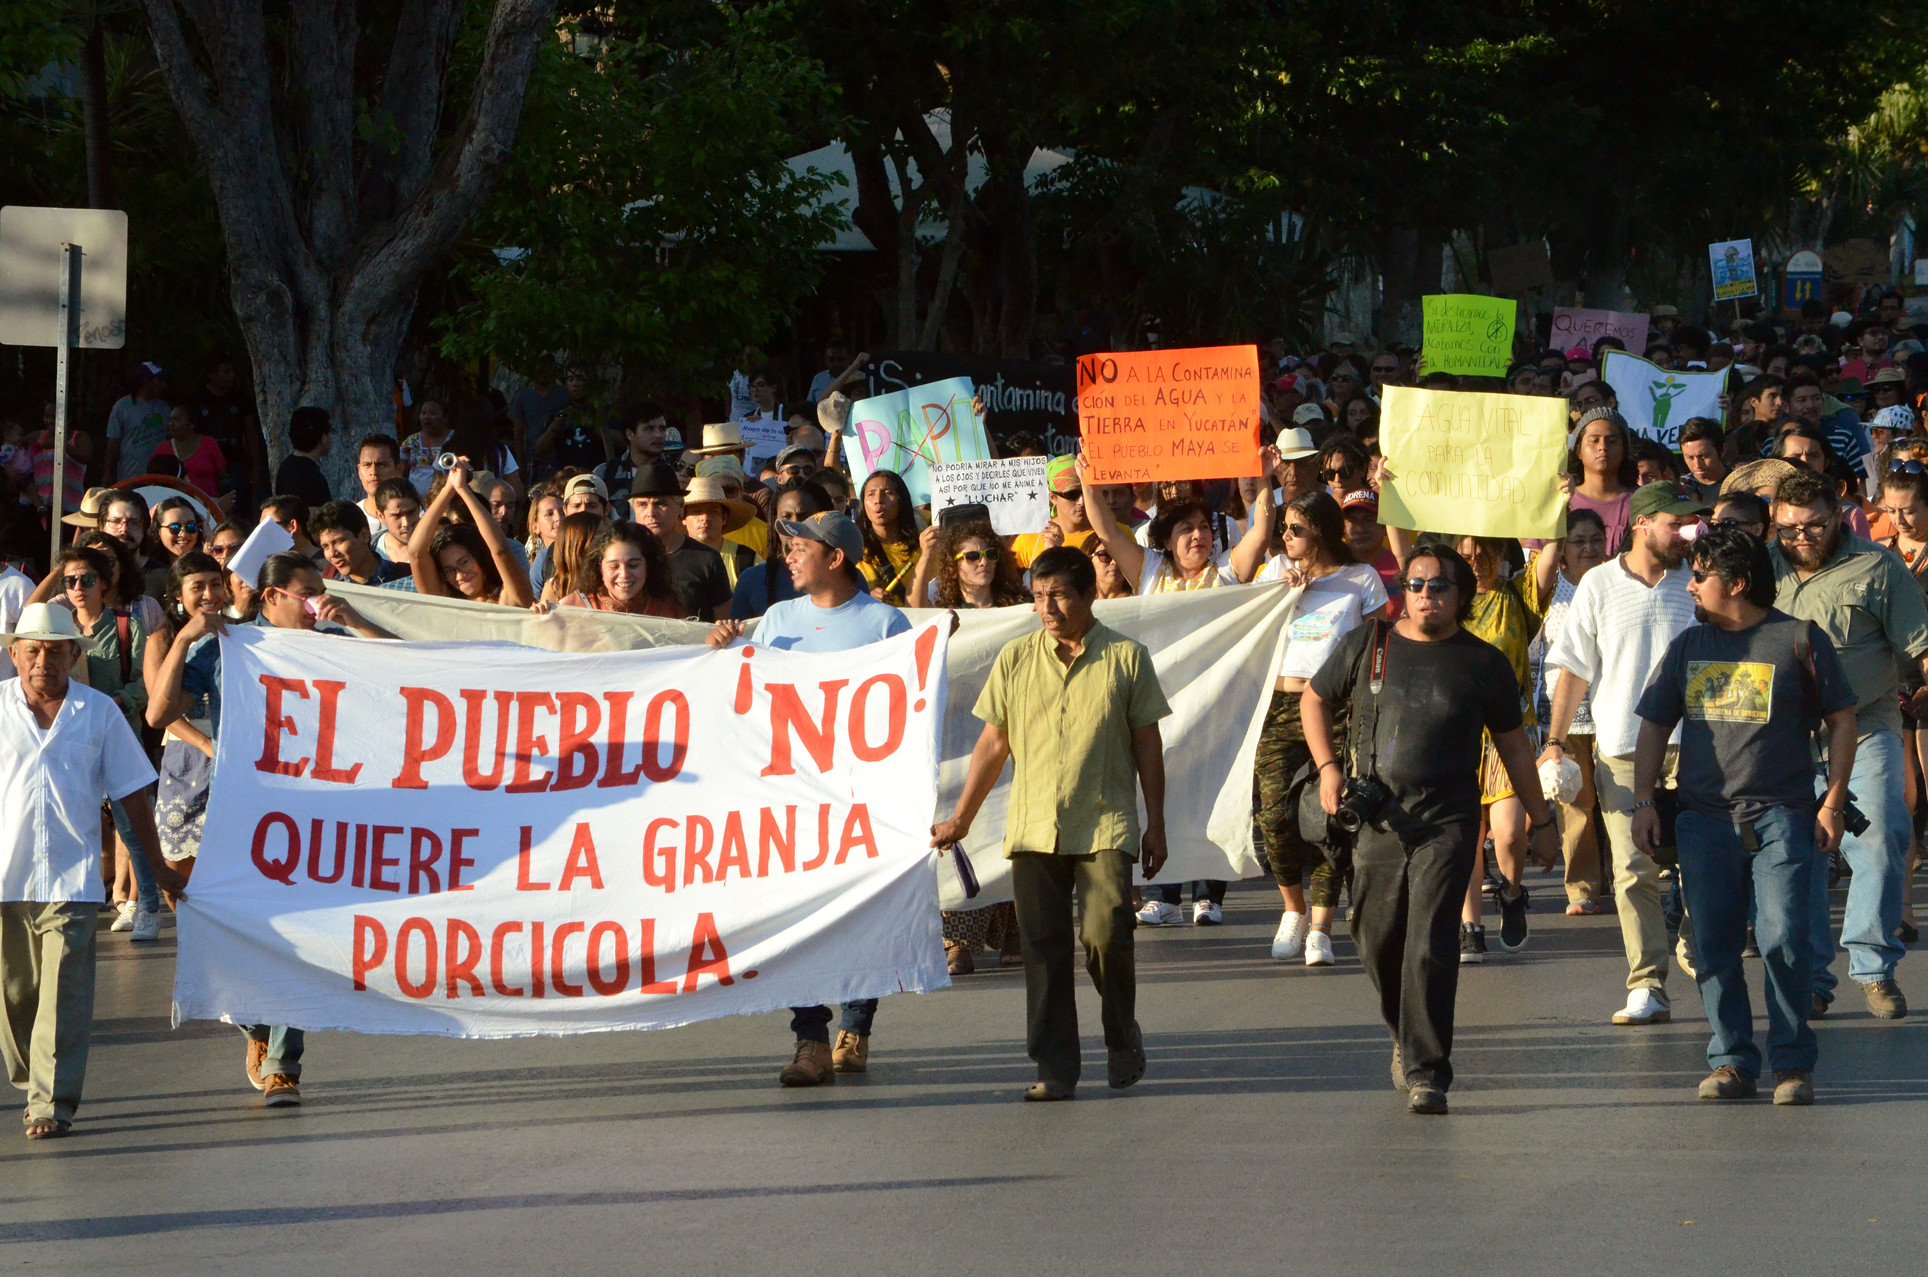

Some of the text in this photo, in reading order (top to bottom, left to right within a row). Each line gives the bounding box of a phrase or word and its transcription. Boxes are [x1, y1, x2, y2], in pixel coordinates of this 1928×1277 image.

[1555, 314, 1637, 340] QUEREMOS
[1126, 366, 1140, 383] A
[1146, 366, 1166, 383] LA
[978, 371, 1066, 416] ontamina
[1124, 394, 1147, 407] DEL
[1154, 386, 1207, 408] AGUA
[1215, 393, 1224, 405] Y
[1232, 392, 1247, 404] LA
[1083, 415, 1146, 435] TIERRA
[1159, 418, 1175, 431] EN
[1417, 403, 1530, 436] AGUA VITAL
[1113, 443, 1163, 459] PUEBLO
[1172, 438, 1215, 457] MAYA
[1224, 441, 1240, 454] SE
[1428, 445, 1493, 465] PARA LA
[932, 464, 943, 473] NO
[975, 461, 998, 469] MIRAR
[1000, 460, 1006, 468] A
[1008, 458, 1021, 467] MIS
[1023, 457, 1046, 466] HIJOS
[936, 467, 1045, 483] A LOS OJOS Y DECIRLES QUE VIVEN
[970, 483, 986, 491] QUE
[1002, 481, 1012, 489] ME
[1038, 479, 1043, 487] A
[1405, 470, 1526, 504] COMUNIDAD
[1375, 647, 1384, 673] Canon
[256, 674, 363, 785] EL
[392, 687, 690, 793] PUEBLO
[252, 802, 879, 894] QUIERE LA GRANJA
